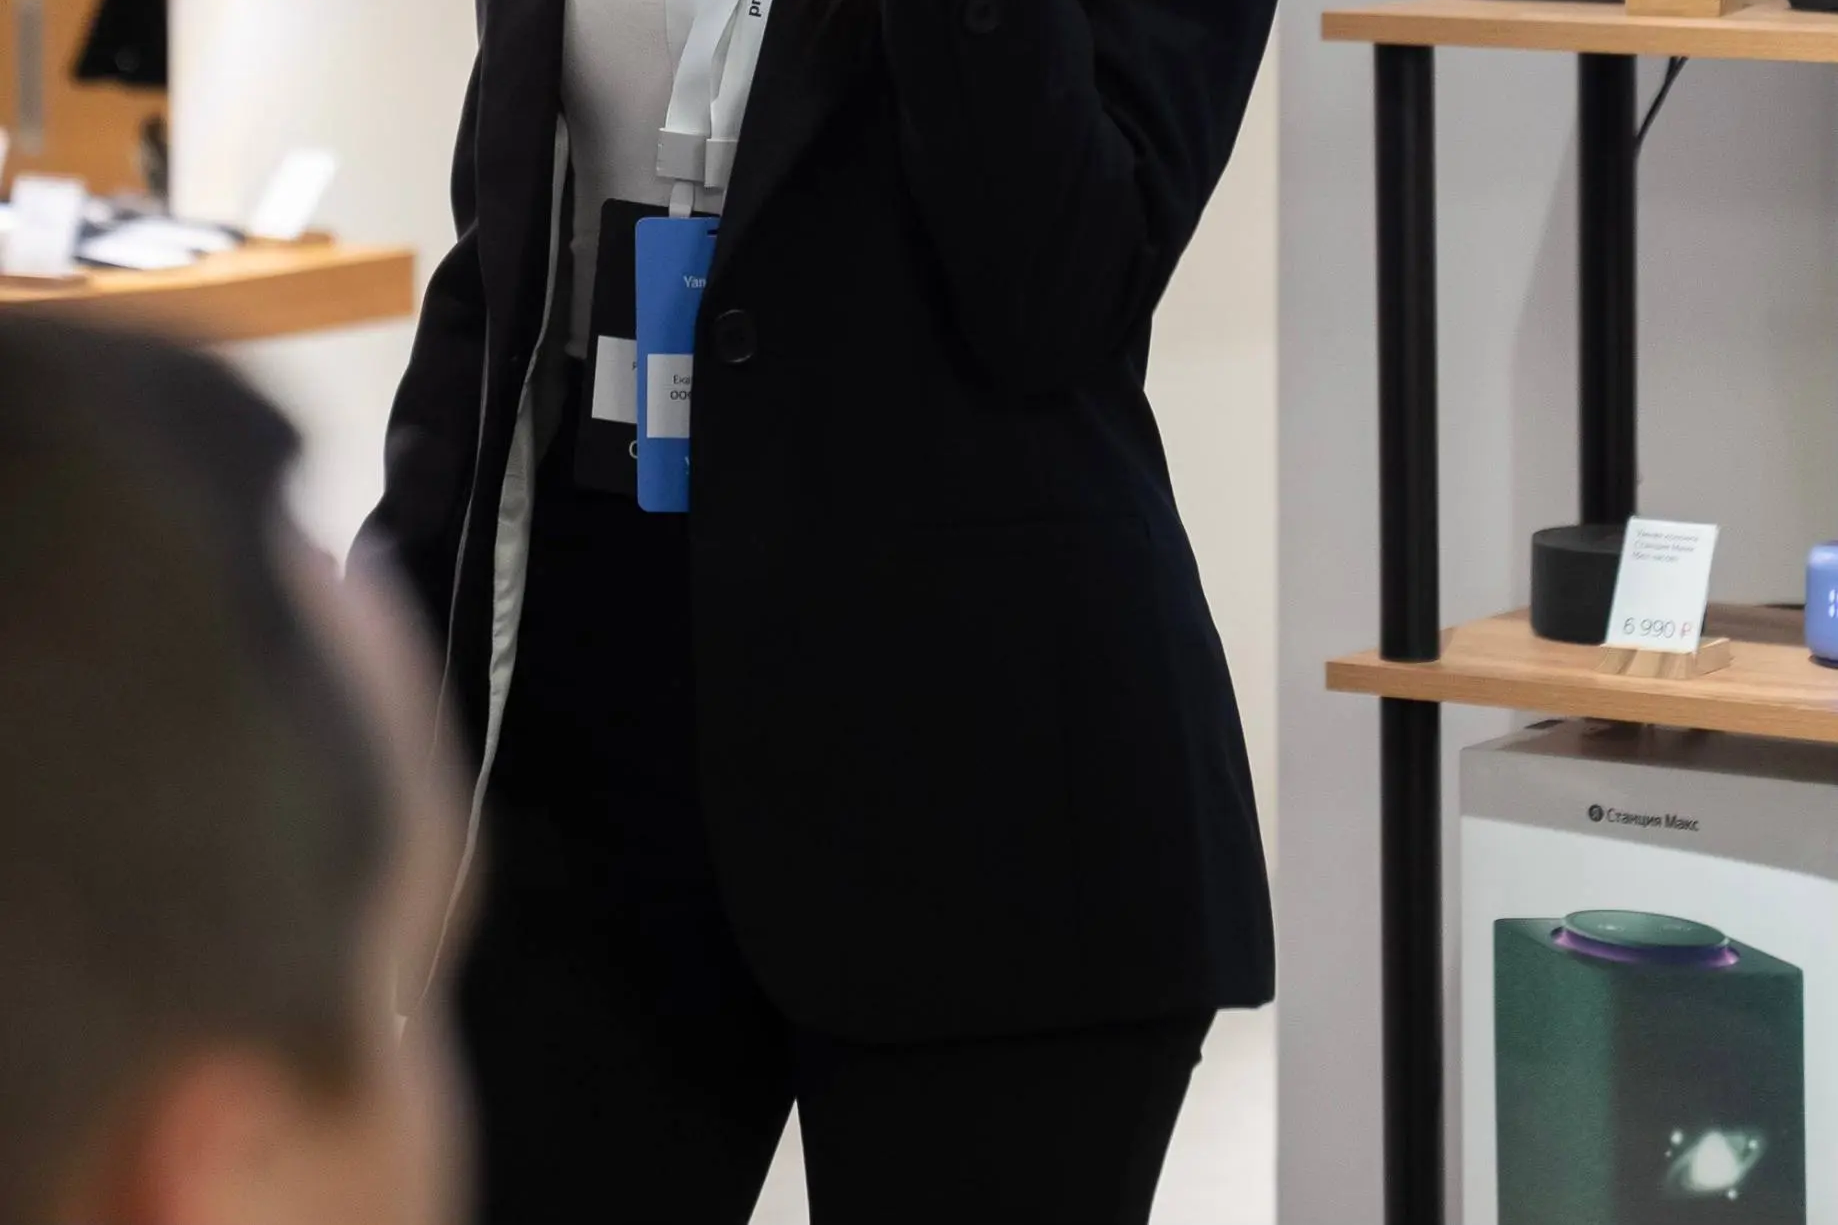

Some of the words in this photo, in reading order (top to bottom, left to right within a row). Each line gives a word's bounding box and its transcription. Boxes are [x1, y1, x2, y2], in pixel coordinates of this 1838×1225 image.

[683, 275, 707, 289] Yan
[1622, 617, 1635, 635] 6
[1640, 618, 1676, 638] 990
[1606, 807, 1663, 828] Станция
[1665, 813, 1700, 832] Макс
